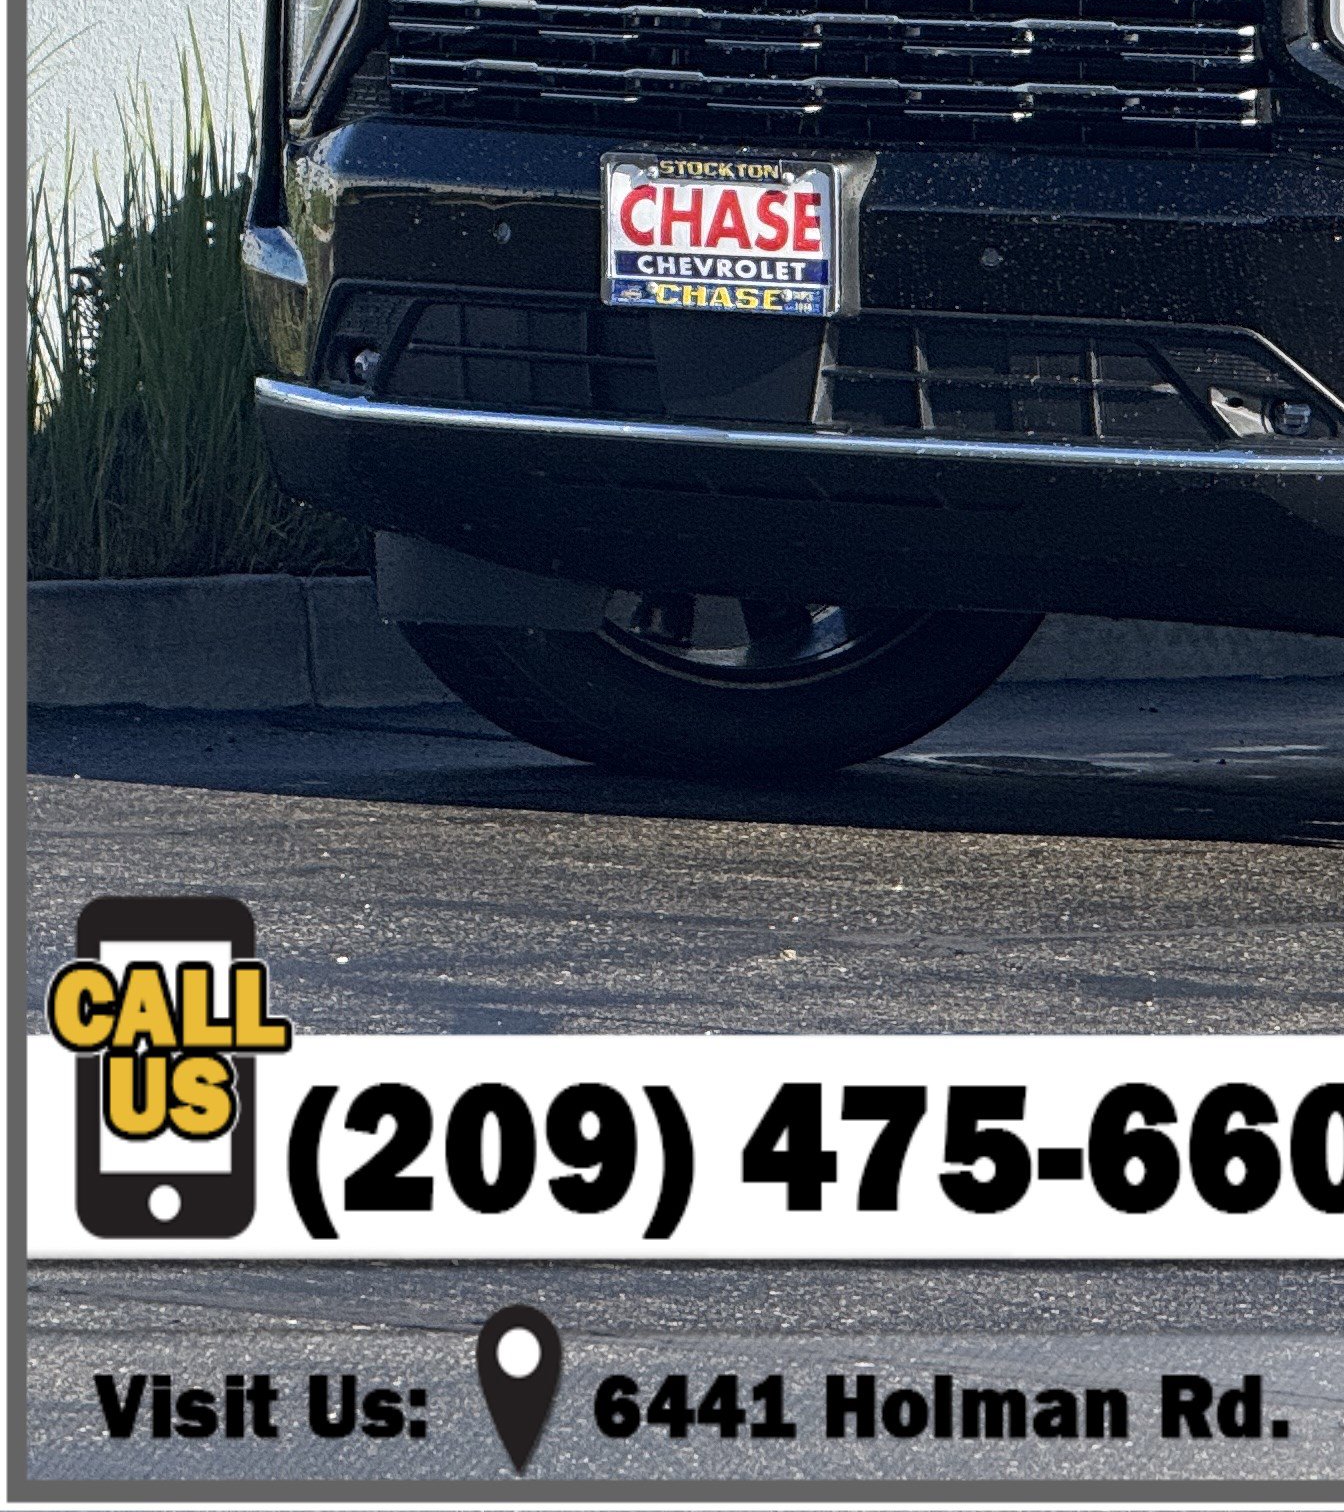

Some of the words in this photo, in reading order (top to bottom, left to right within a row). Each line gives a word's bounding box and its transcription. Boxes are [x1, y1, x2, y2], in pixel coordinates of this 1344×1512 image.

[659, 159, 781, 180] STOCKTON
[619, 184, 823, 253] CHASE
[636, 254, 807, 282] CHEVROLET
[655, 283, 784, 311] CHASE
